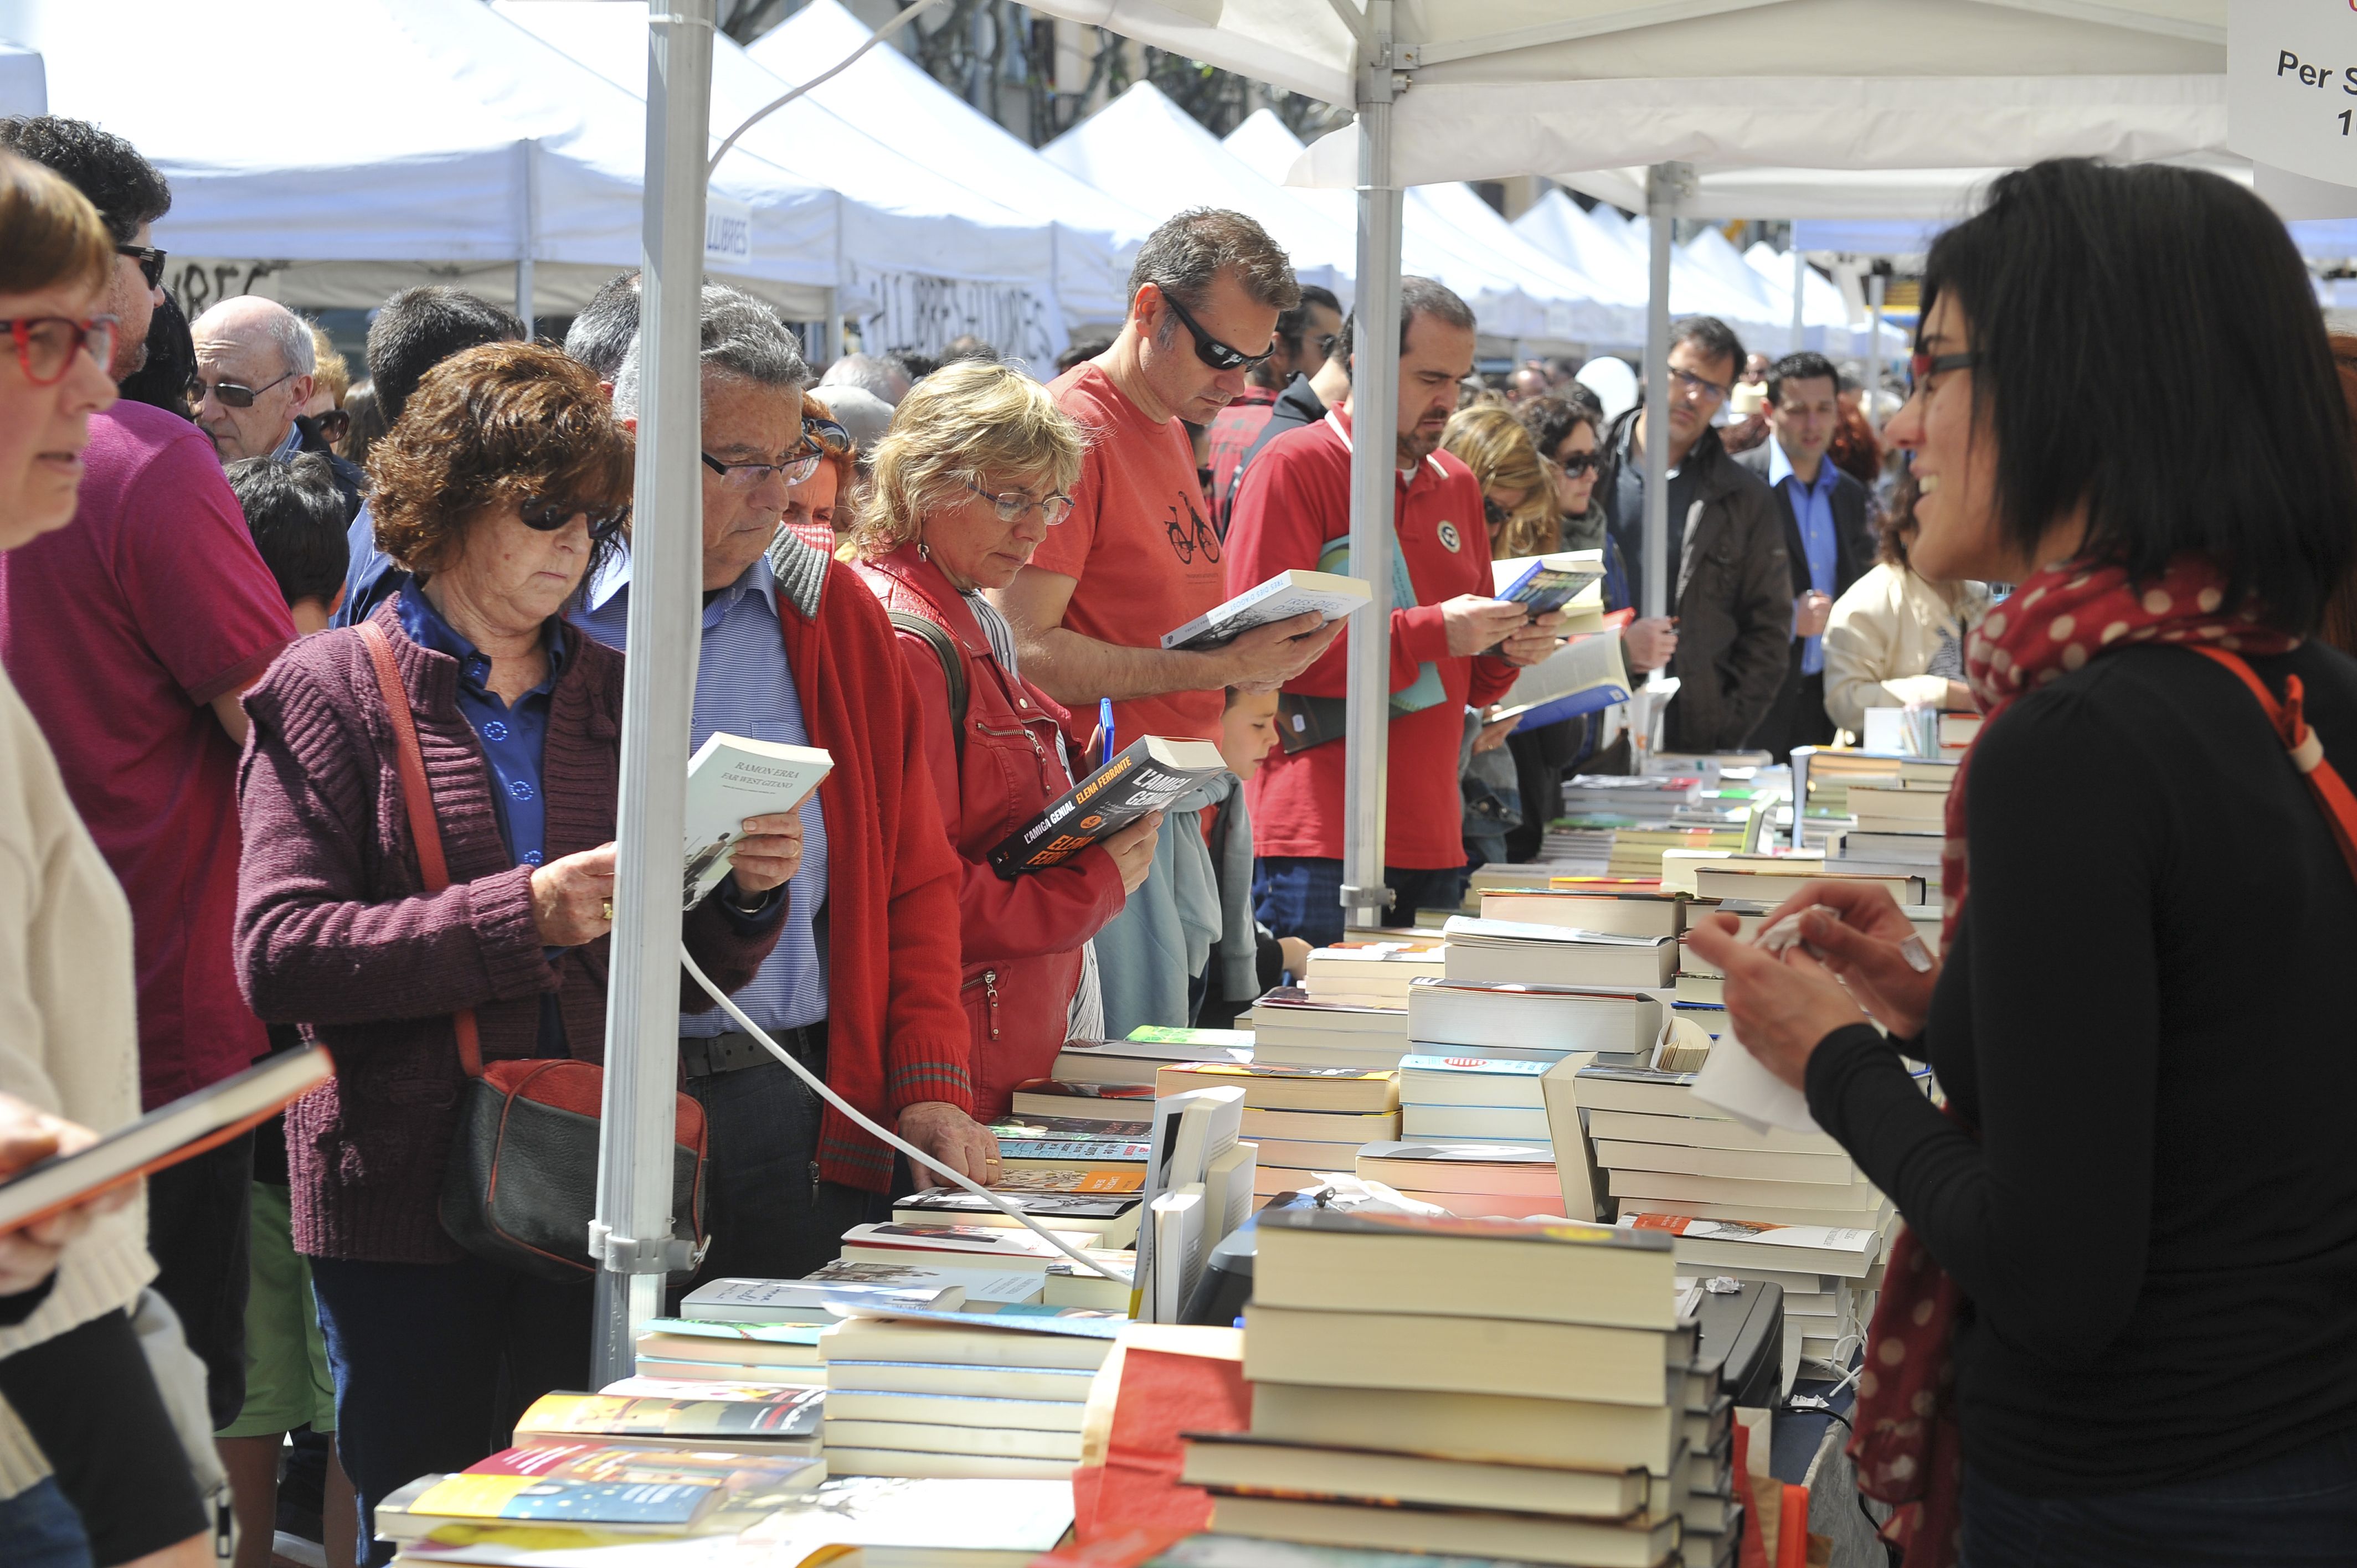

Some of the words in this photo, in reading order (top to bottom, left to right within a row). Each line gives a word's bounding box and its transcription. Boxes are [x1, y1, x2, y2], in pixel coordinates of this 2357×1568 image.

[2277, 49, 2333, 89] Per
[2343, 67, 2357, 95] S
[707, 214, 748, 255] LLIBRES
[1256, 587, 1269, 598] DIES
[1270, 579, 1284, 591] TRES
[1273, 604, 1330, 614] D'AGOT
[1284, 597, 1314, 606] TRES
[1314, 600, 1343, 610] DIES
[734, 761, 774, 775] RAMON
[773, 768, 800, 779] ERRA
[721, 772, 739, 782] FAR
[739, 776, 763, 786] WEST
[761, 780, 794, 789] GITANO
[1075, 782, 1099, 804] ELENA
[1097, 755, 1133, 788] FERRANTE
[1132, 768, 1193, 792] L'AMIGA
[1023, 818, 1052, 844] L'AMIGA
[1050, 800, 1076, 824] GENIAL
[1046, 834, 1097, 850] ELENA
